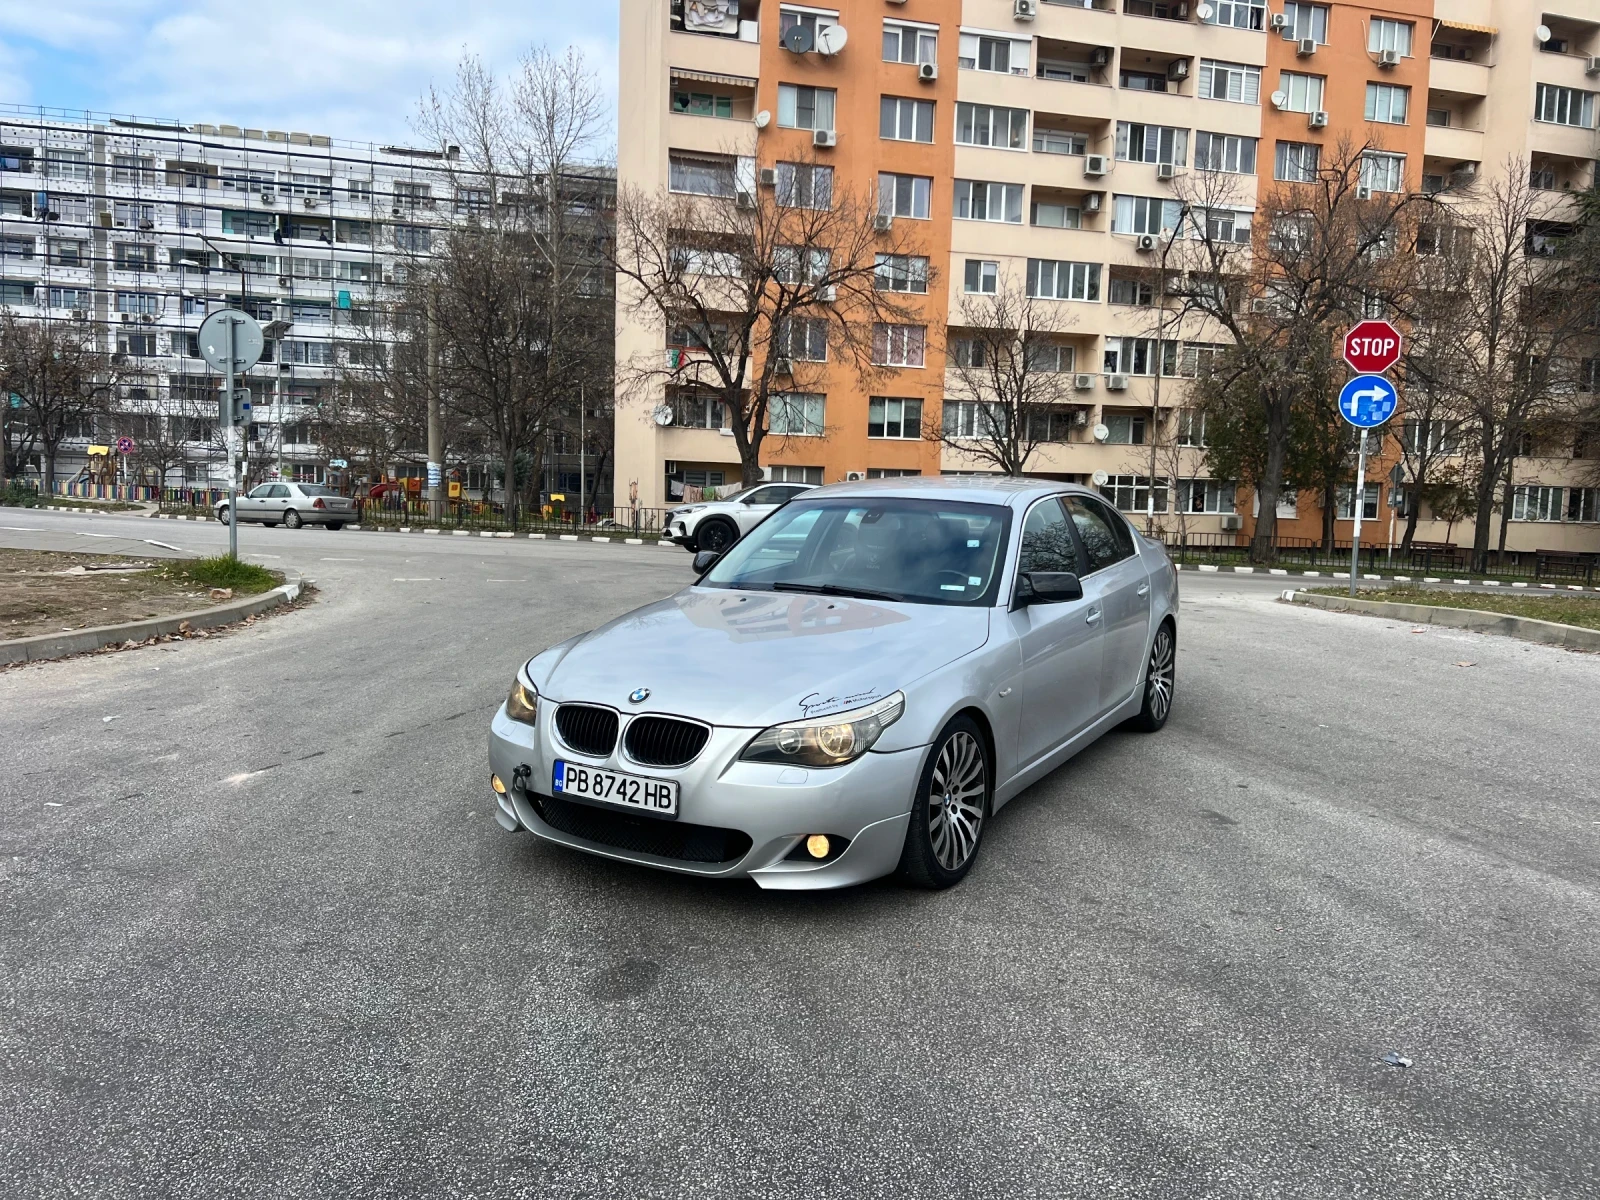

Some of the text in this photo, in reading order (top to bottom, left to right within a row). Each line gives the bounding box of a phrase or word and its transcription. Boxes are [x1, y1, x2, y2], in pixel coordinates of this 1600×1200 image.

[1350, 338, 1394, 356] STOP
[555, 779, 563, 787] BG
[565, 767, 671, 809] PB 8742 HB
